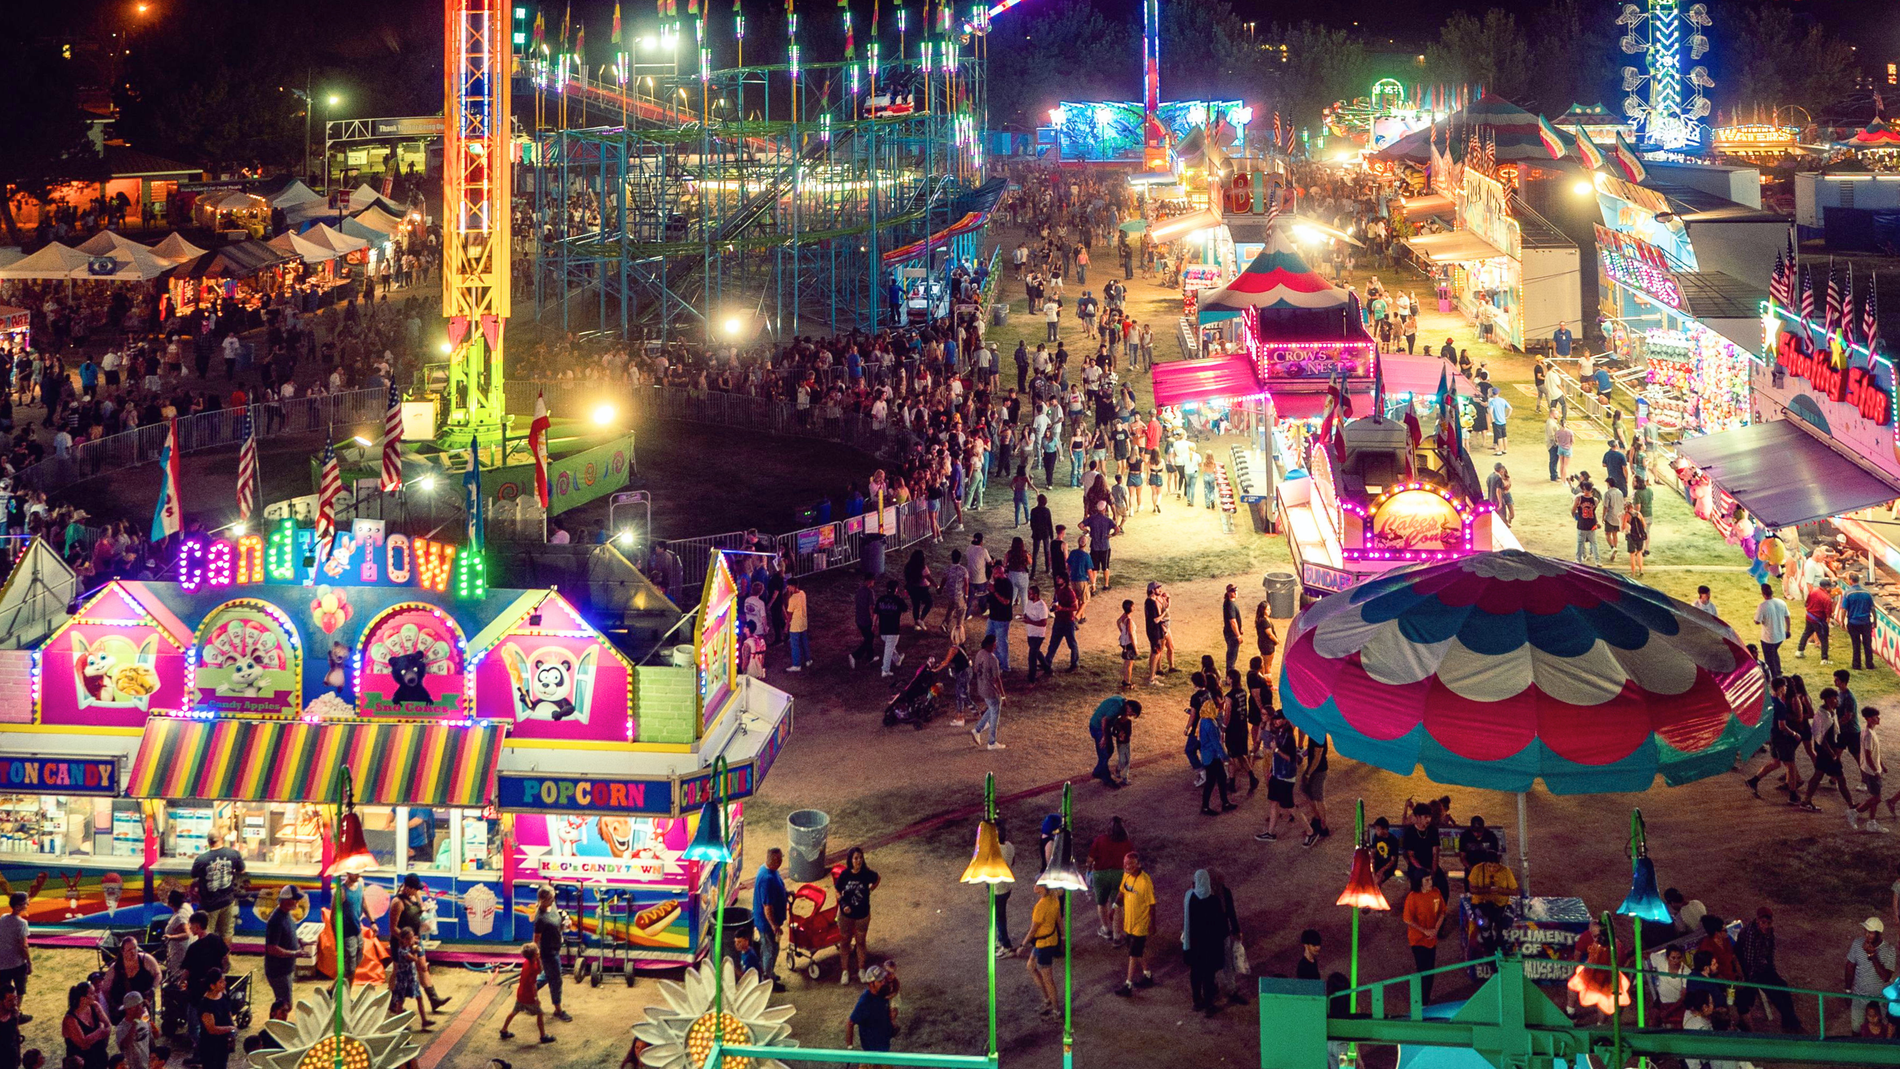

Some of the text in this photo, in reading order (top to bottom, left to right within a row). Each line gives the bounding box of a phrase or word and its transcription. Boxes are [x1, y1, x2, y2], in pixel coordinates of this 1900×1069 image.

[1718, 128, 1791, 141] WATERS
[208, 700, 280, 711] Candy Apples
[376, 702, 448, 713] Sno Cones
[43, 762, 112, 787] CANDY
[523, 780, 645, 807] POPCORN
[681, 779, 710, 807] COLD
[582, 863, 622, 873] CANDY
[1522, 943, 1543, 955] OF
[1524, 961, 1576, 979] MUSEMEN
